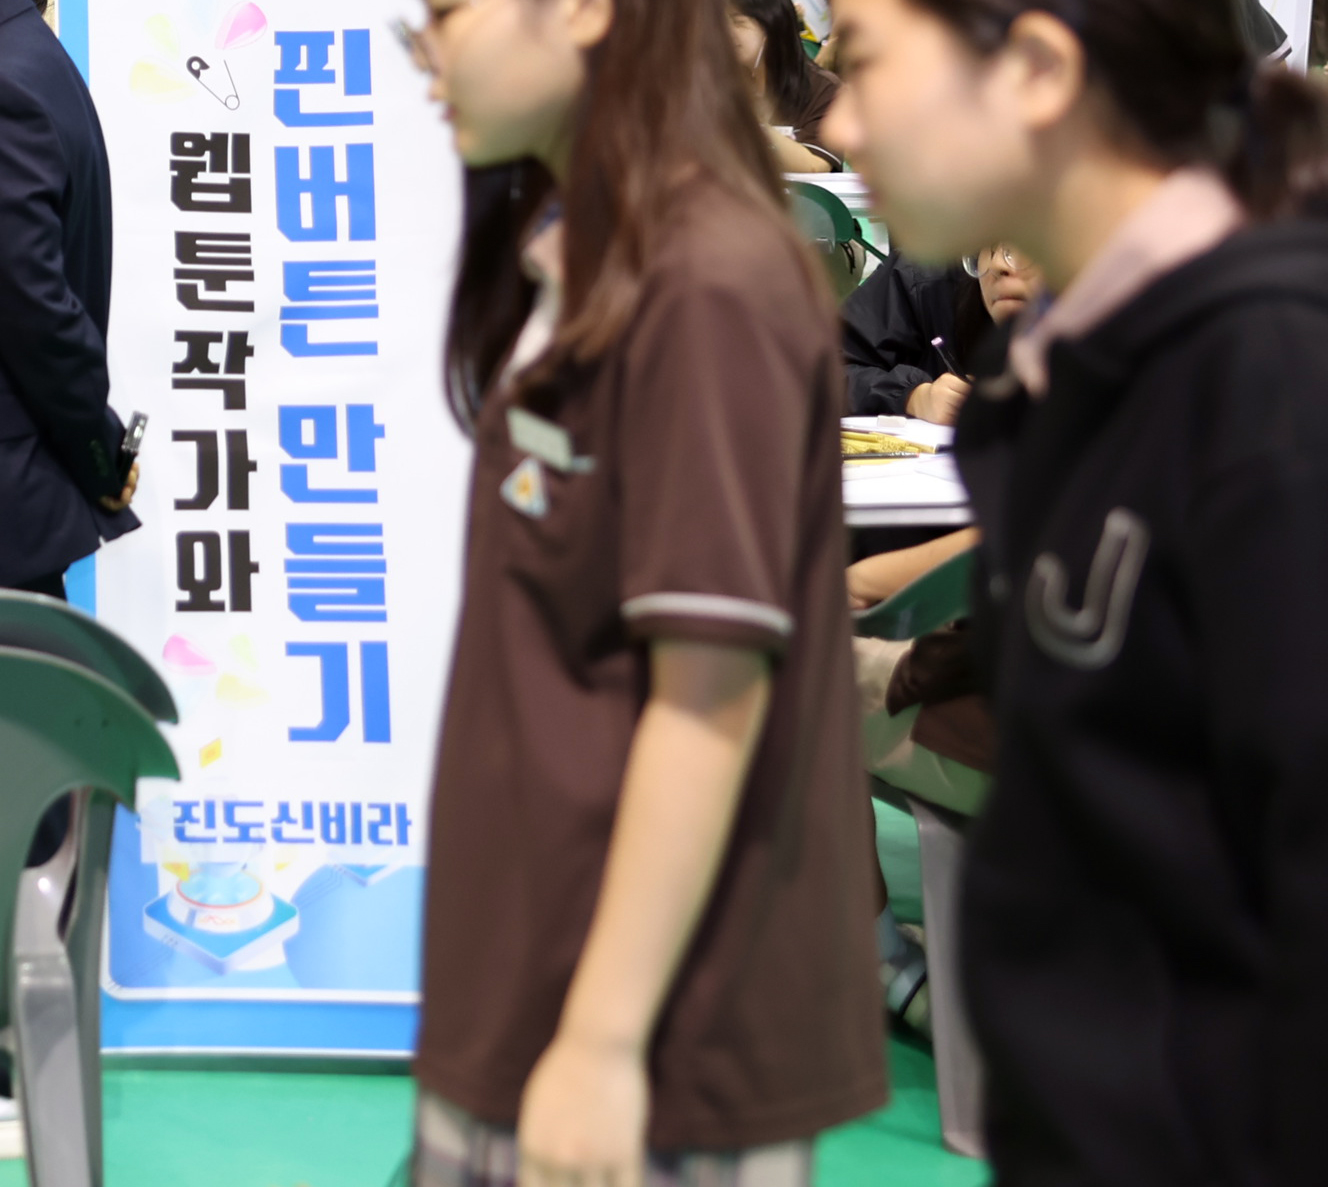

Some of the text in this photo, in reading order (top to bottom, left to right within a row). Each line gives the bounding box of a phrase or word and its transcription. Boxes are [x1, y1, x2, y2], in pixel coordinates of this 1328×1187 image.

[273, 28, 392, 744] 핀버튼 만들기
[172, 800, 412, 846] 진도신비라
